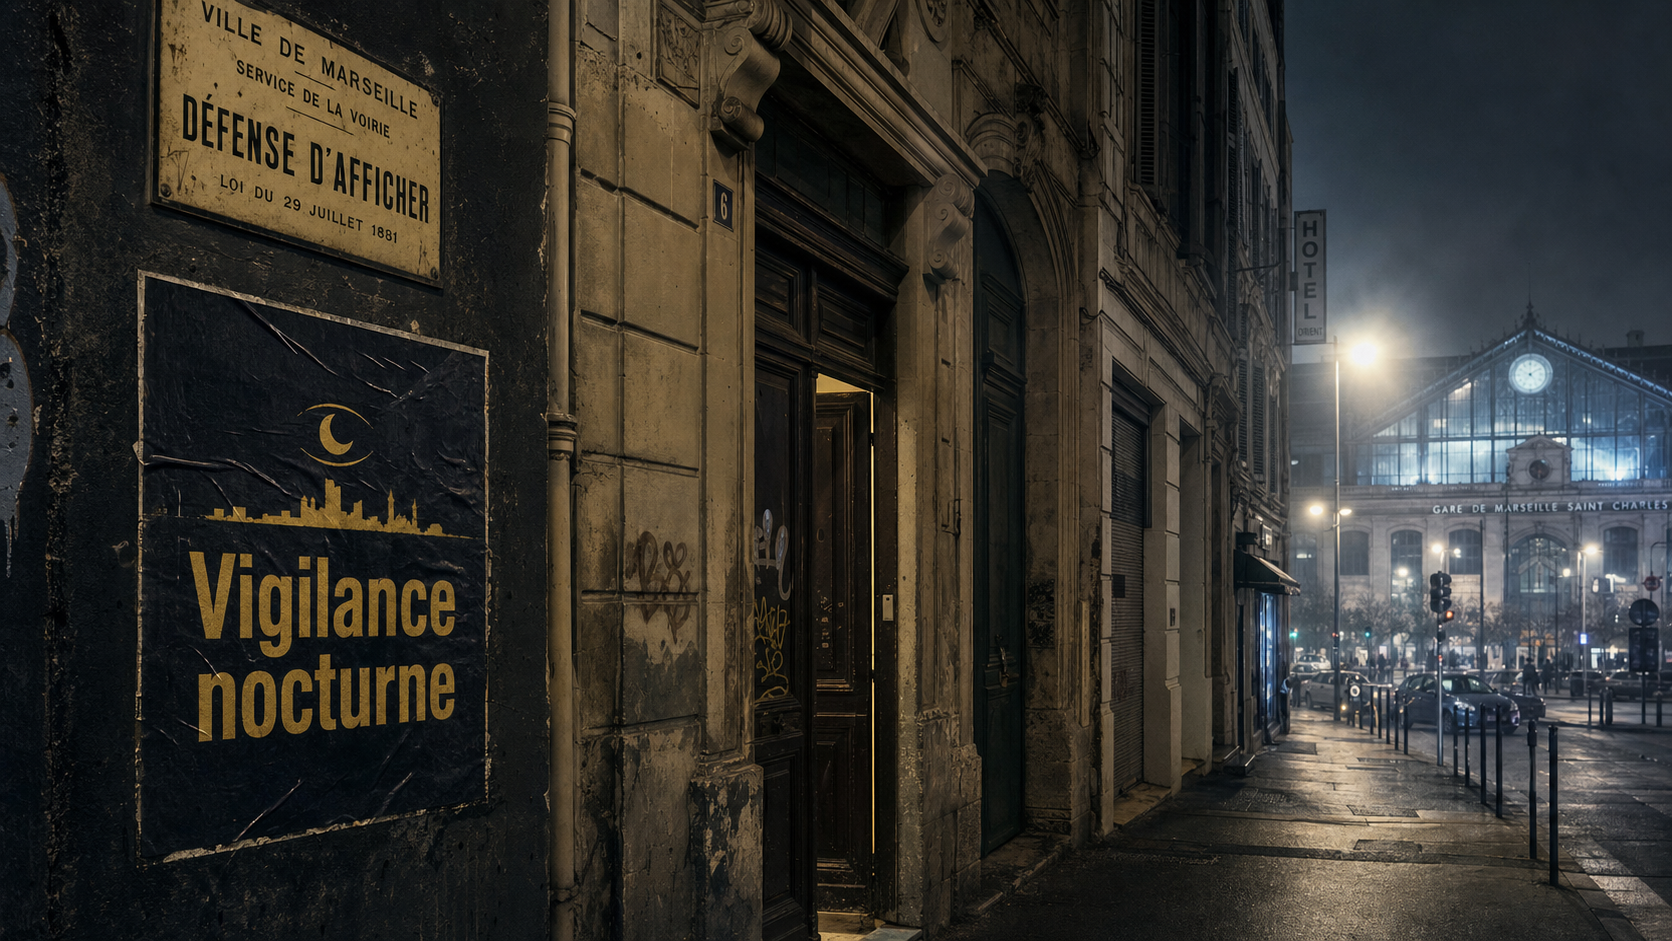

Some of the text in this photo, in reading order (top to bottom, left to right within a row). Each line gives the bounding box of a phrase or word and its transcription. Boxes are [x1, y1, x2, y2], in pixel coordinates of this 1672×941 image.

[202, 0, 418, 120] VILLE DE MARSEILLE
[236, 59, 390, 139] SERVICE DE LA VOIRIE
[182, 93, 429, 224] DÉFENSE D'AFFICHER
[220, 174, 398, 244] LOI DU 29 JUILLET 1881
[720, 192, 728, 220] 6
[1302, 220, 1319, 320] HOTEL
[1297, 327, 1323, 336] ORIENT
[1432, 500, 1668, 514] GARE DE MARSEILLE SAINT CHARLES
[188, 551, 456, 658] Vigilance
[198, 654, 456, 742] nocturne
